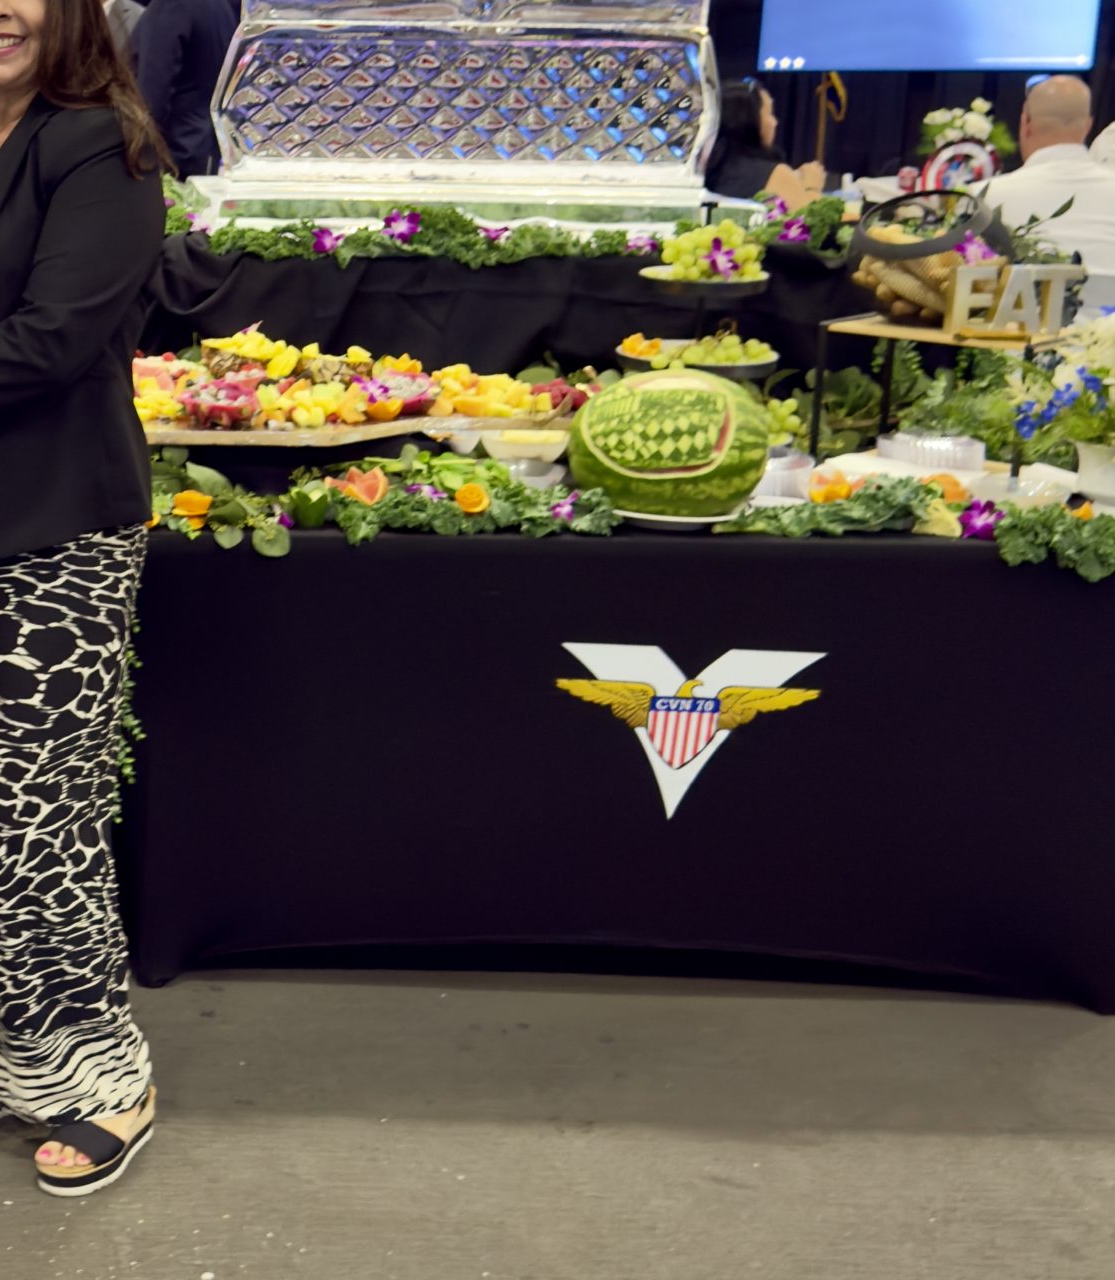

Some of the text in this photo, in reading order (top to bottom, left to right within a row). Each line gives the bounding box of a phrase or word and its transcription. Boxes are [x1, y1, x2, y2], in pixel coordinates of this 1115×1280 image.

[948, 263, 1087, 336] EAT
[655, 699, 714, 711] CVN 70
